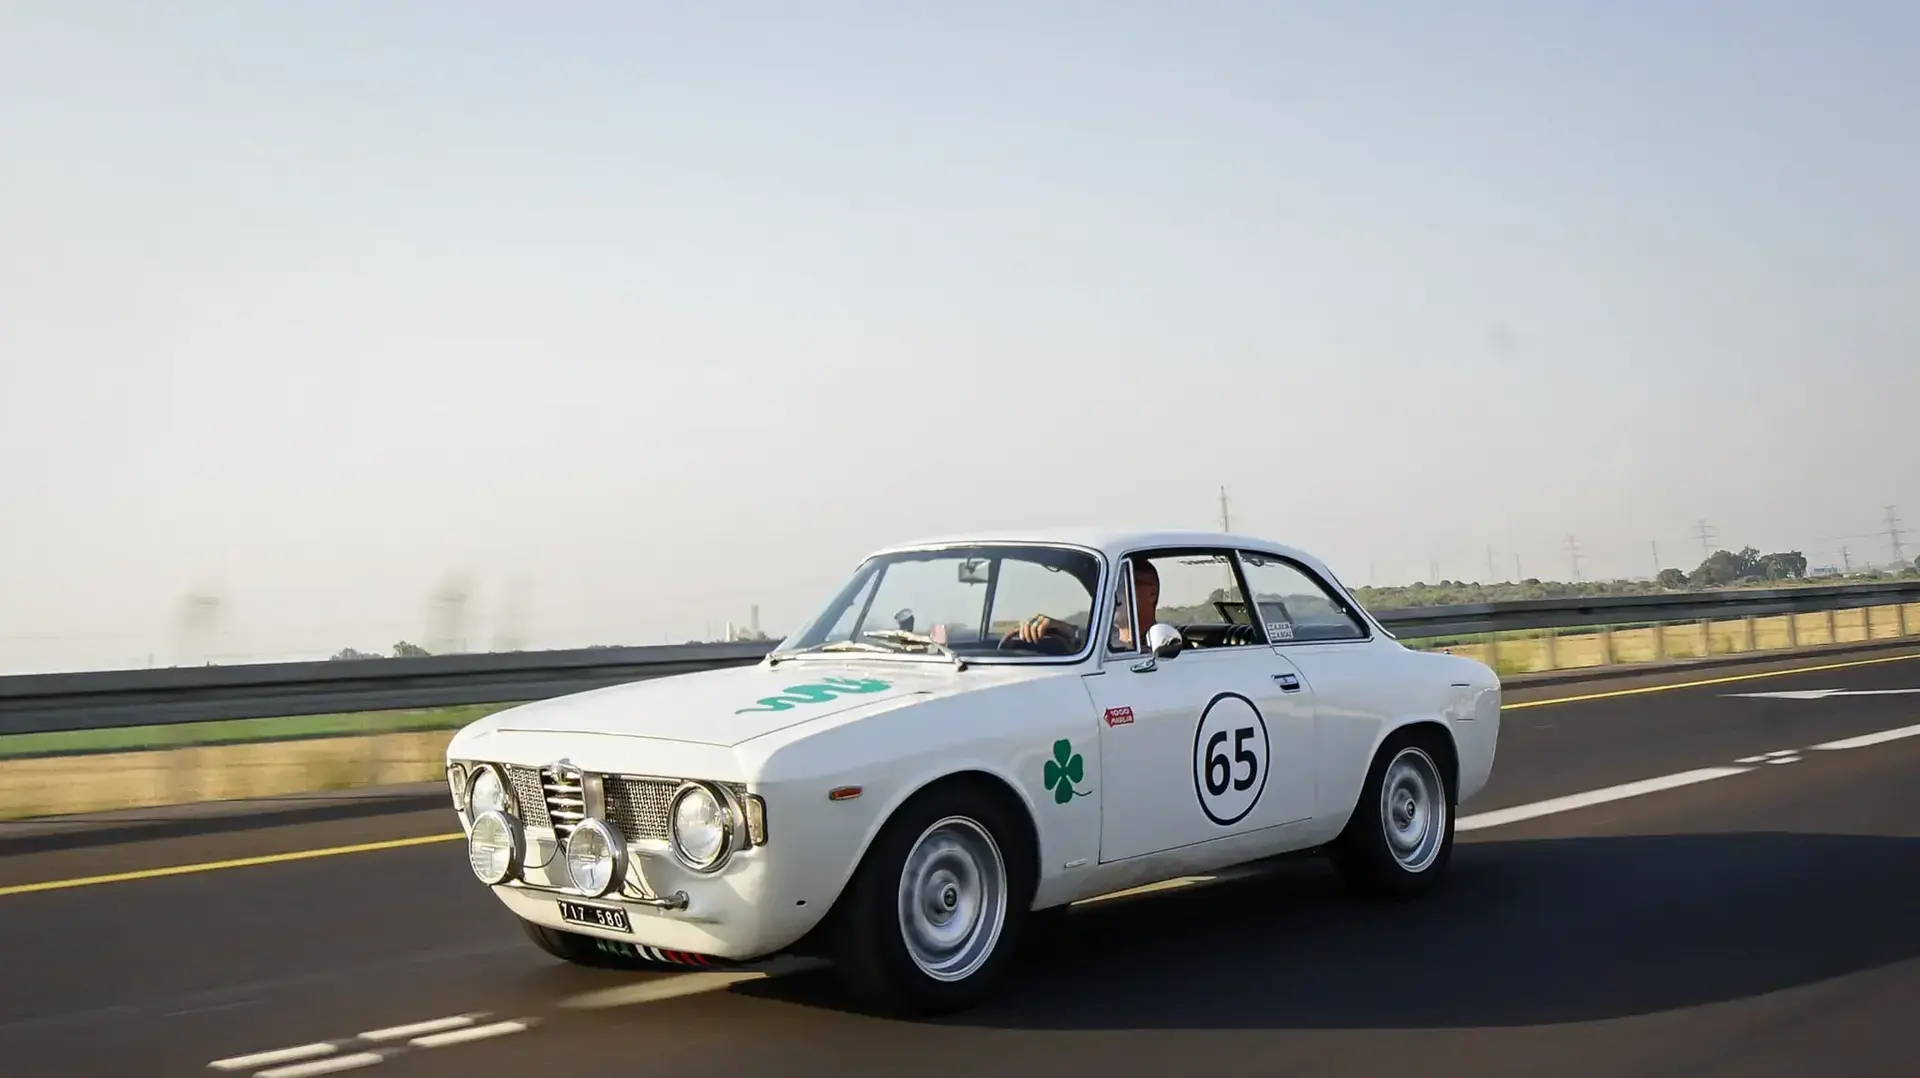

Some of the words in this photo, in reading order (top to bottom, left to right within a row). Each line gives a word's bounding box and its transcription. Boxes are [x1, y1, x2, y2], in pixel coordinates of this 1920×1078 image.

[1205, 727, 1258, 797] 65
[561, 903, 584, 921] 717
[596, 909, 623, 928] 580
